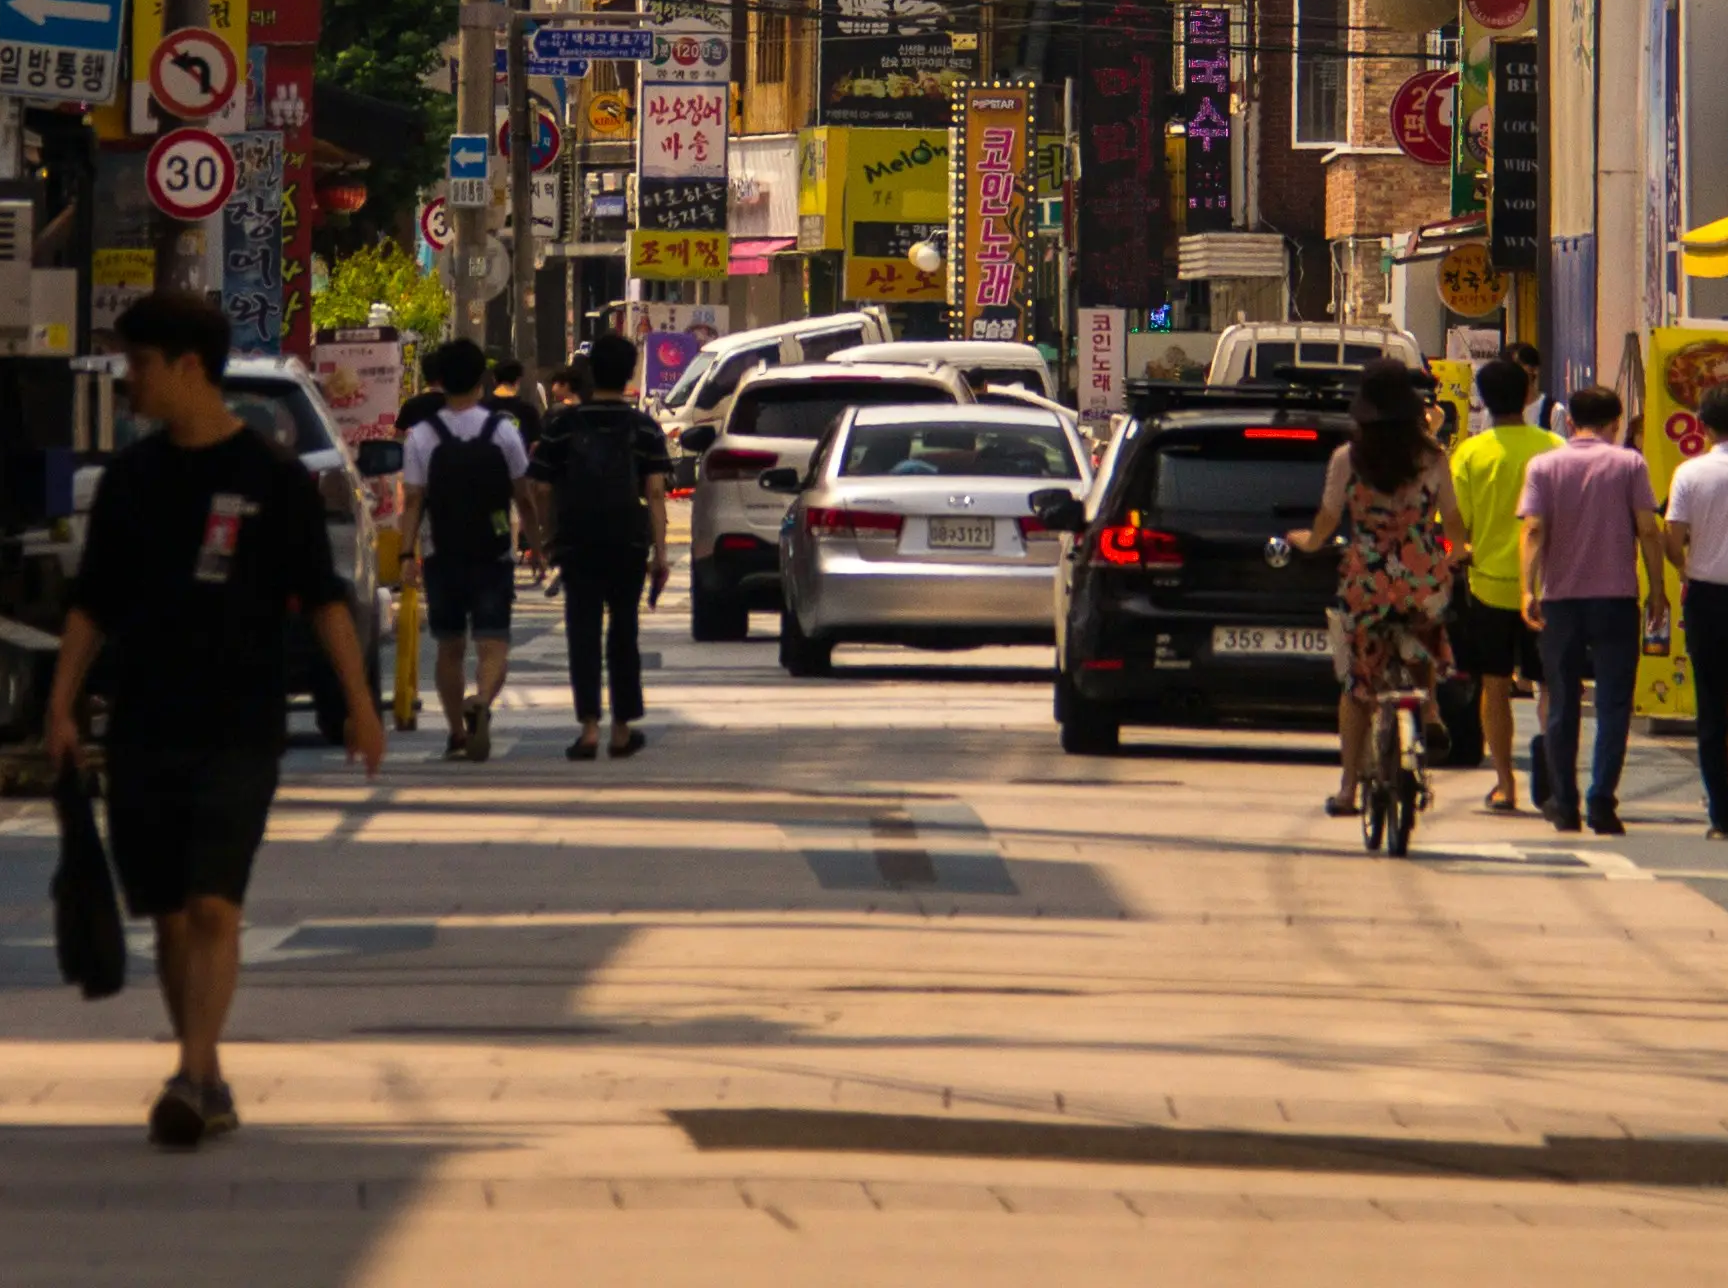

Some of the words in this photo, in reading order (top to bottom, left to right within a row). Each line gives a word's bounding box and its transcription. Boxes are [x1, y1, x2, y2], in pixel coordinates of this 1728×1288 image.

[0, 44, 105, 96] 일방통행
[164, 155, 218, 192] 30
[975, 127, 1016, 307] 코인노래
